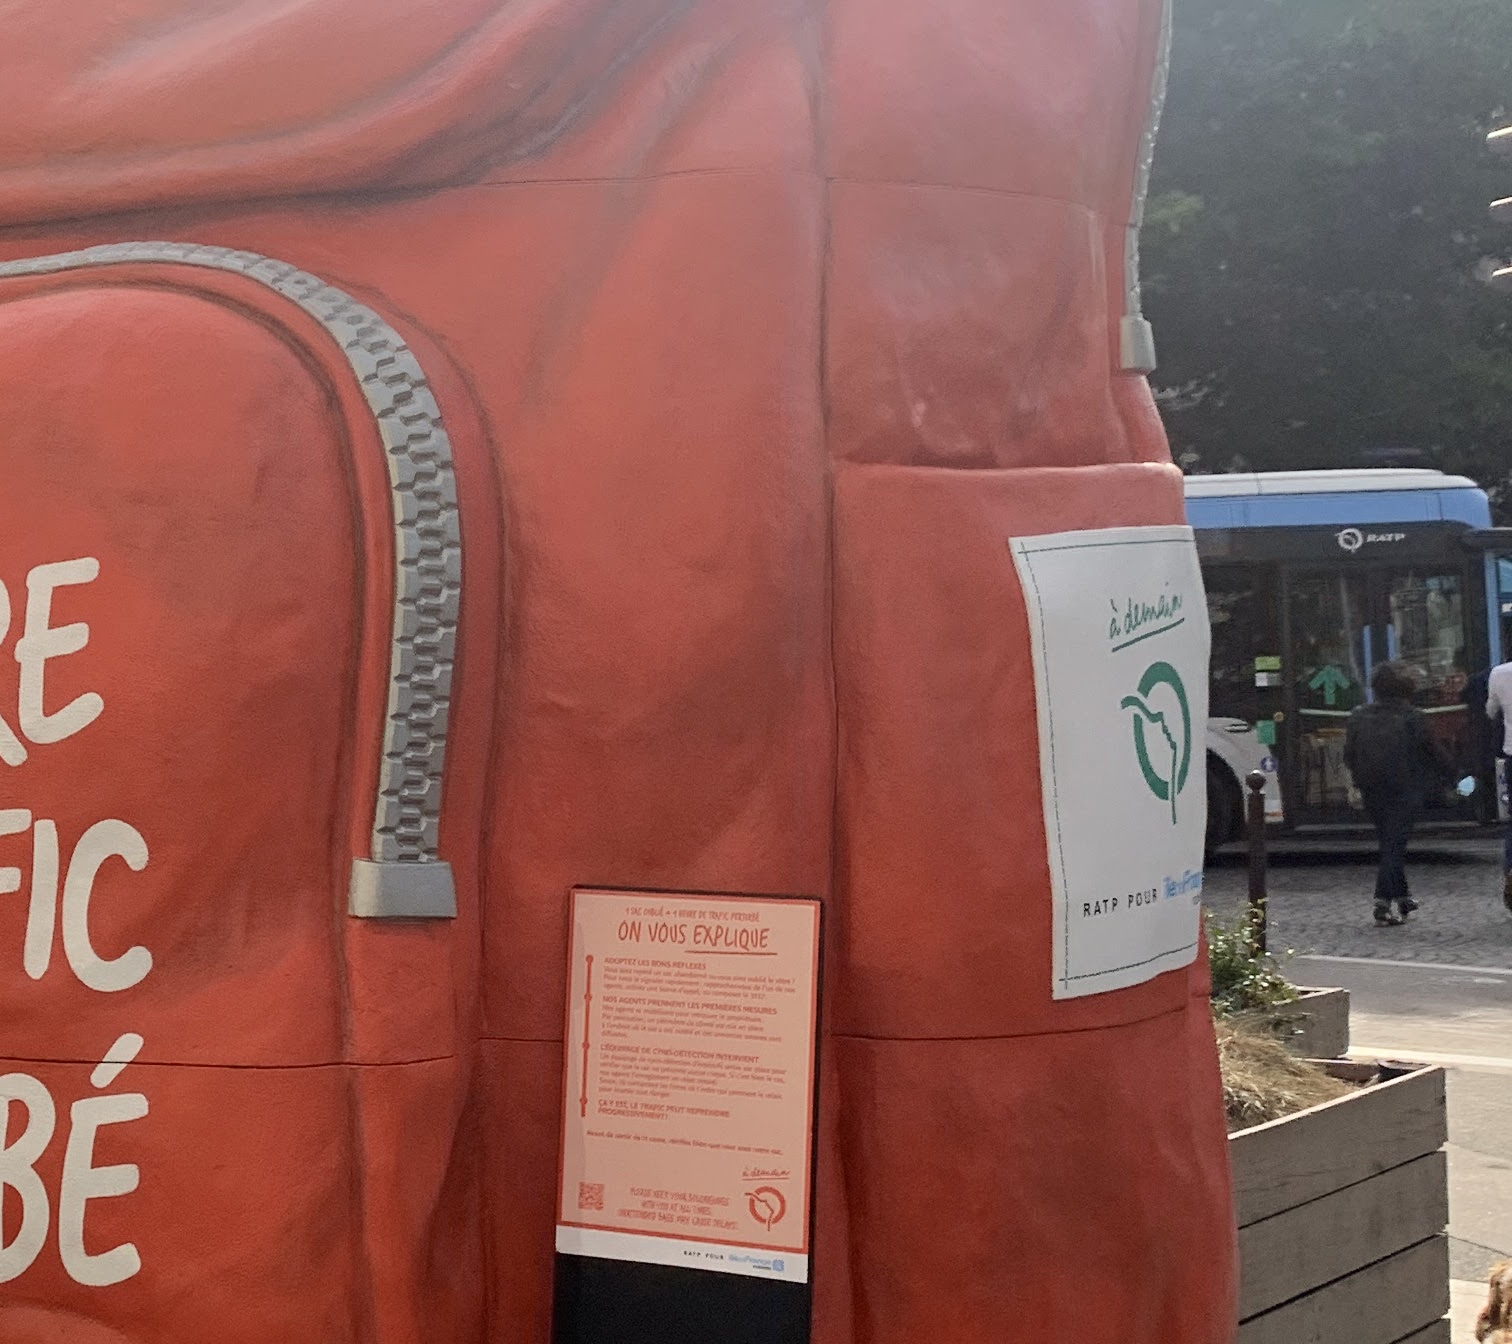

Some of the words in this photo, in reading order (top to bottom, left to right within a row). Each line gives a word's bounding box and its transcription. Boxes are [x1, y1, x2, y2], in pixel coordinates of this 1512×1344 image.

[1367, 533, 1406, 543] RATP
[1083, 897, 1118, 917] RATP
[1128, 888, 1157, 909] POUR
[618, 920, 641, 942] ON
[648, 922, 687, 944] VOUS
[693, 924, 770, 951] EXPLIQUE
